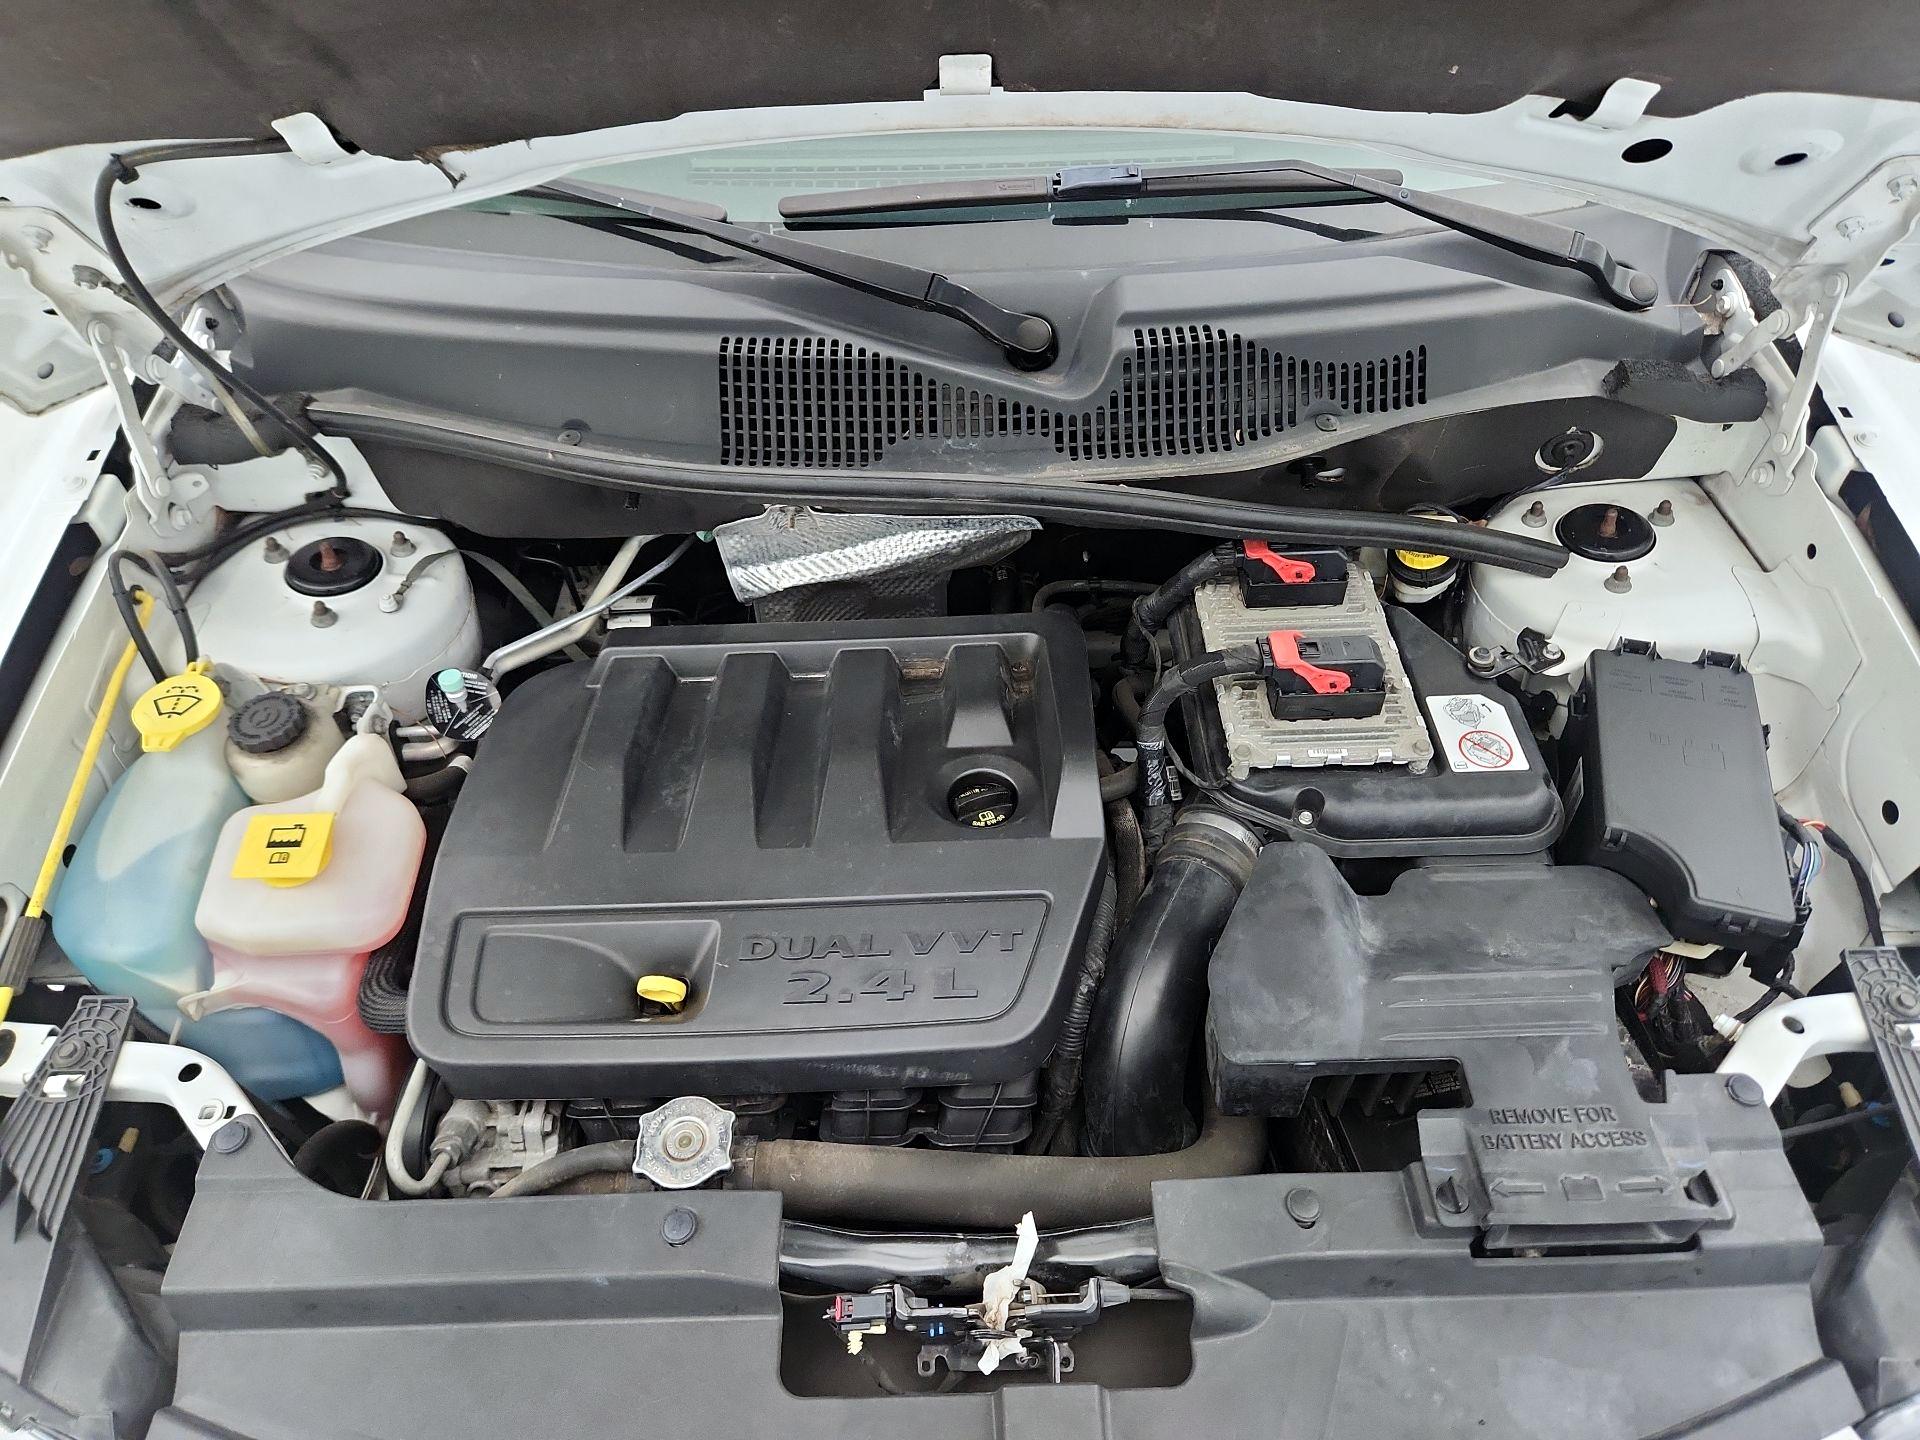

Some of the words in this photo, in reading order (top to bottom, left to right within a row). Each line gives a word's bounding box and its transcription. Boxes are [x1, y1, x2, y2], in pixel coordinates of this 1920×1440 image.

[738, 933, 892, 962] DUAL
[902, 929, 1024, 956] VVT
[1488, 1107, 1572, 1125] REMOVE
[1573, 1106, 1617, 1124] FOR
[1481, 1132, 1563, 1150] BATTERY
[1571, 1130, 1648, 1149] ACCESS
